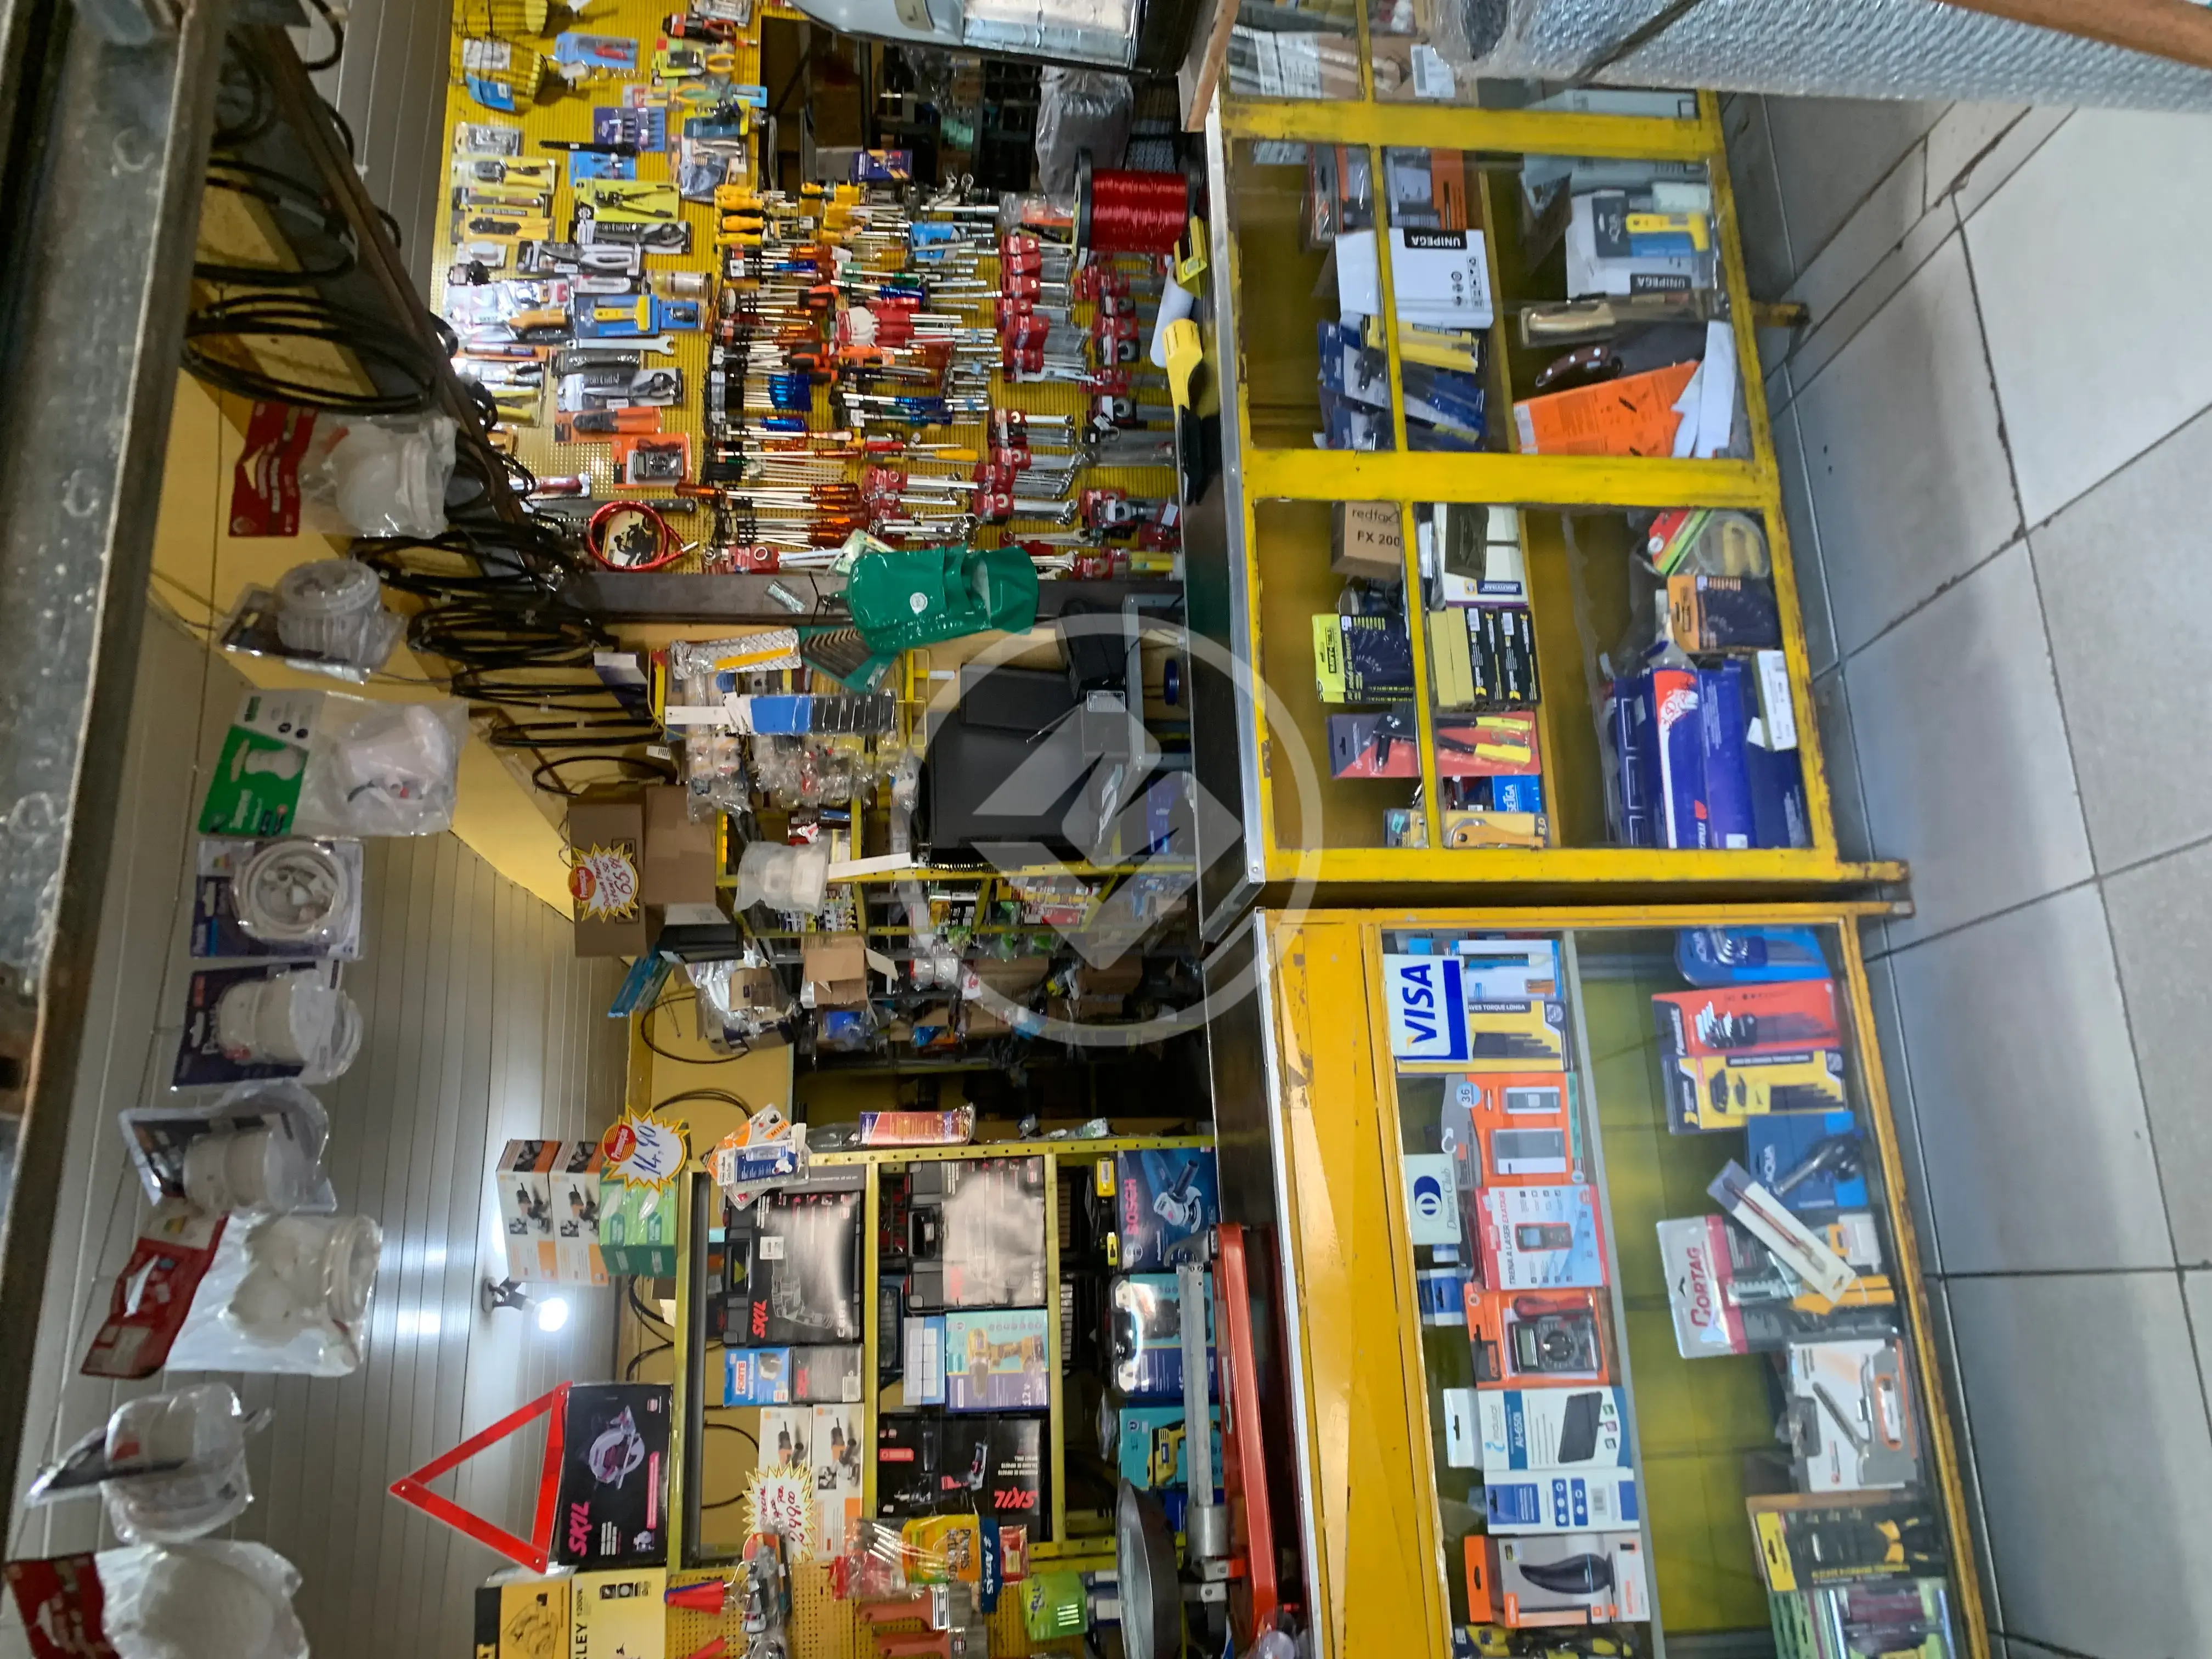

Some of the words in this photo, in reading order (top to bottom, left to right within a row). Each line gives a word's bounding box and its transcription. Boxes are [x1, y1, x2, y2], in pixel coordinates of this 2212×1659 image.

[1410, 234, 1462, 248] UNIPEGA
[1400, 963, 1437, 1052] VISA
[1462, 1088, 1470, 1103] 36
[610, 1127, 629, 1160] Promoção
[770, 1122, 788, 1138] MINI
[1441, 1168, 1453, 1193] Club
[1124, 1178, 1139, 1236] BOSCH
[1445, 1195, 1457, 1229] Diners
[1503, 1224, 1513, 1250] LASER
[1507, 1258, 1516, 1285] TRENA
[1686, 1247, 1712, 1328] CORTAG
[752, 1299, 769, 1339] SKIL
[994, 1486, 1039, 1509] SKIL
[568, 1500, 592, 1557] SKIL
